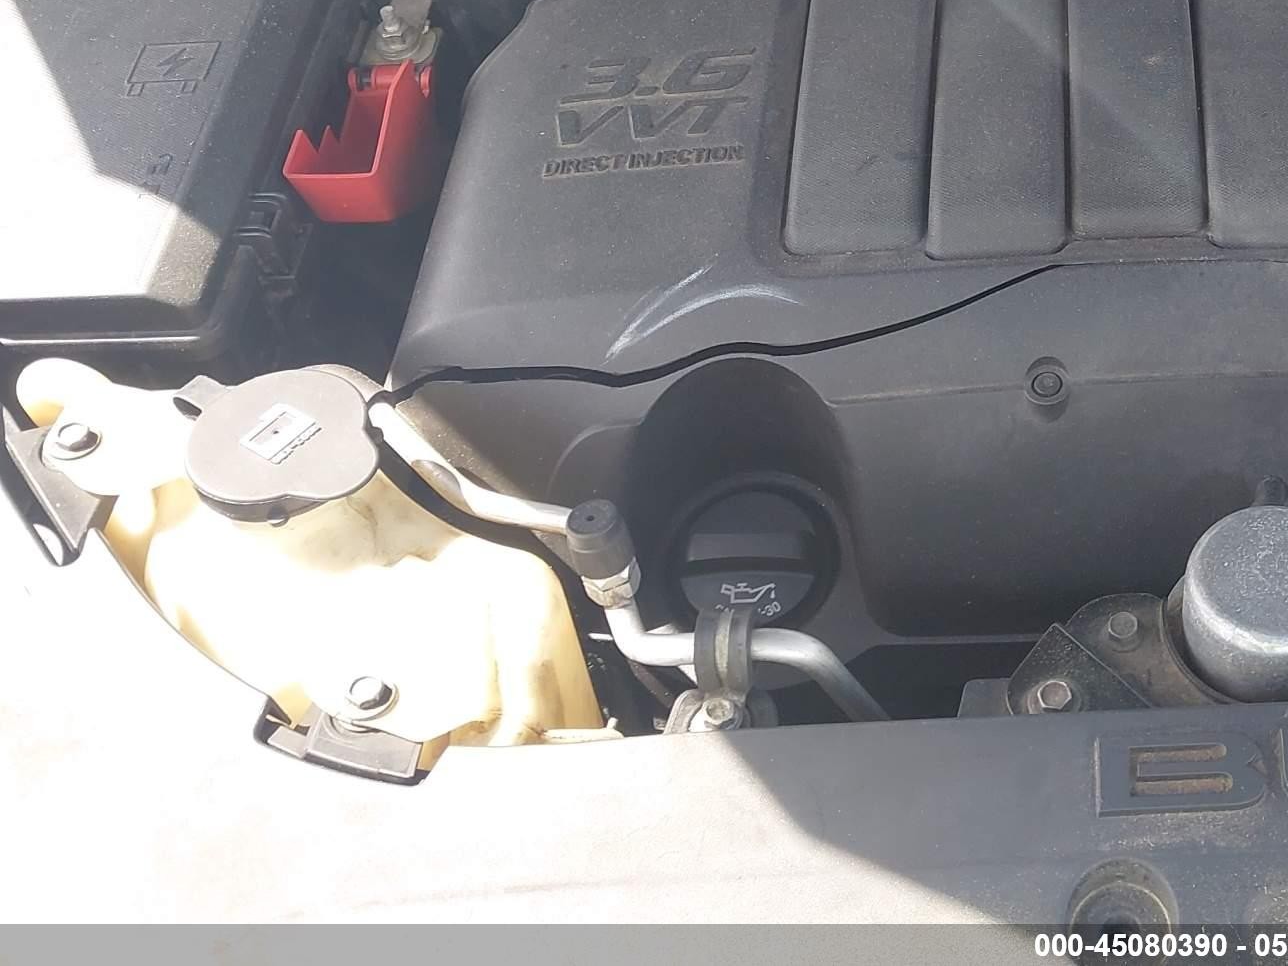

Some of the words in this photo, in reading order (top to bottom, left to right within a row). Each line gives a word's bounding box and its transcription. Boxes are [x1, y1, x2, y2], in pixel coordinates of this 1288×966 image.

[559, 47, 757, 106] 3.6
[555, 96, 749, 148] VVT
[542, 153, 627, 179] DIRECT
[626, 143, 746, 171] INJECTION
